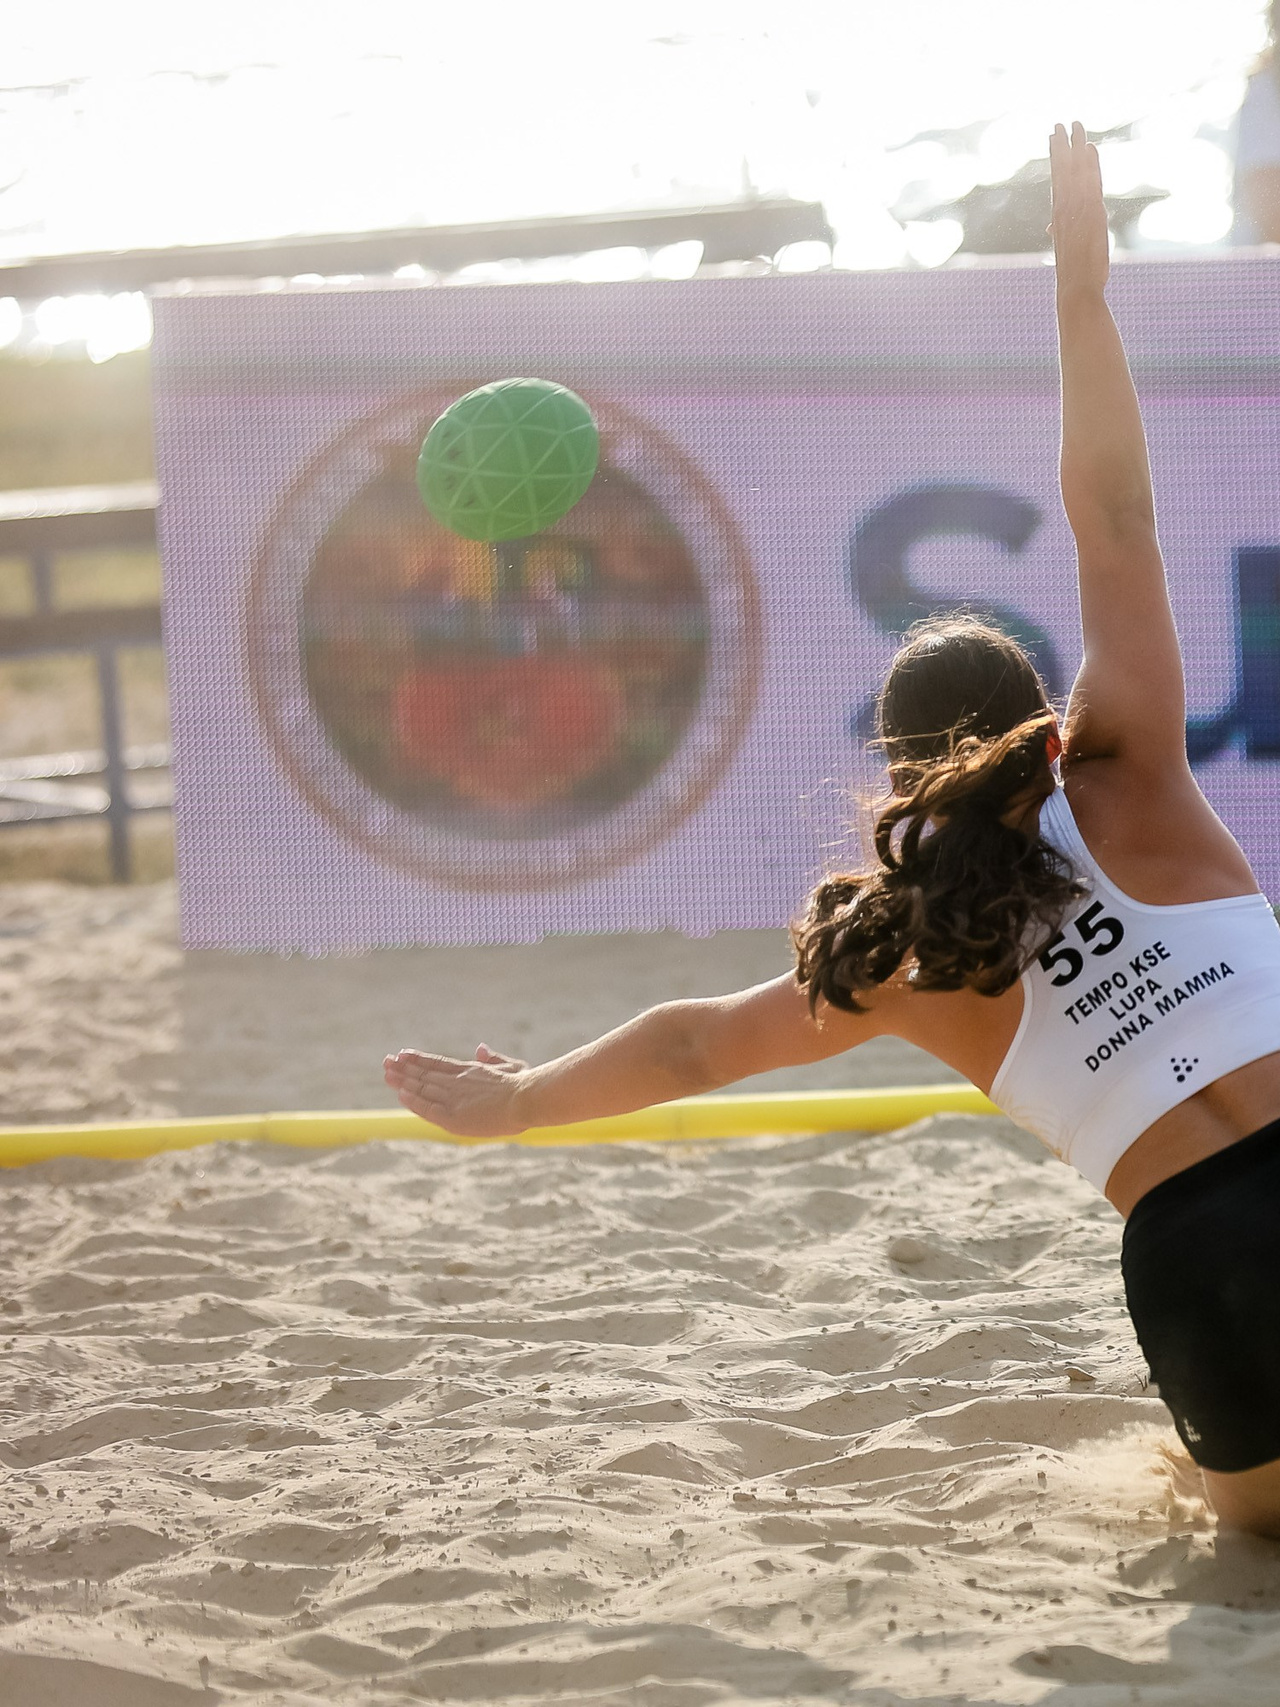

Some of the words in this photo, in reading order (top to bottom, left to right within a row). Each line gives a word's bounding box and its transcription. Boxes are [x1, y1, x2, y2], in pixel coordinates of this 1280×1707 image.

[1040, 900, 1125, 988] 55
[1064, 971, 1128, 1025] TEMPO
[1129, 941, 1172, 977] KSE
[1084, 1013, 1153, 1073] DONNA
[1155, 962, 1235, 1017] MAMMA
[1108, 978, 1163, 1020] LUPA
